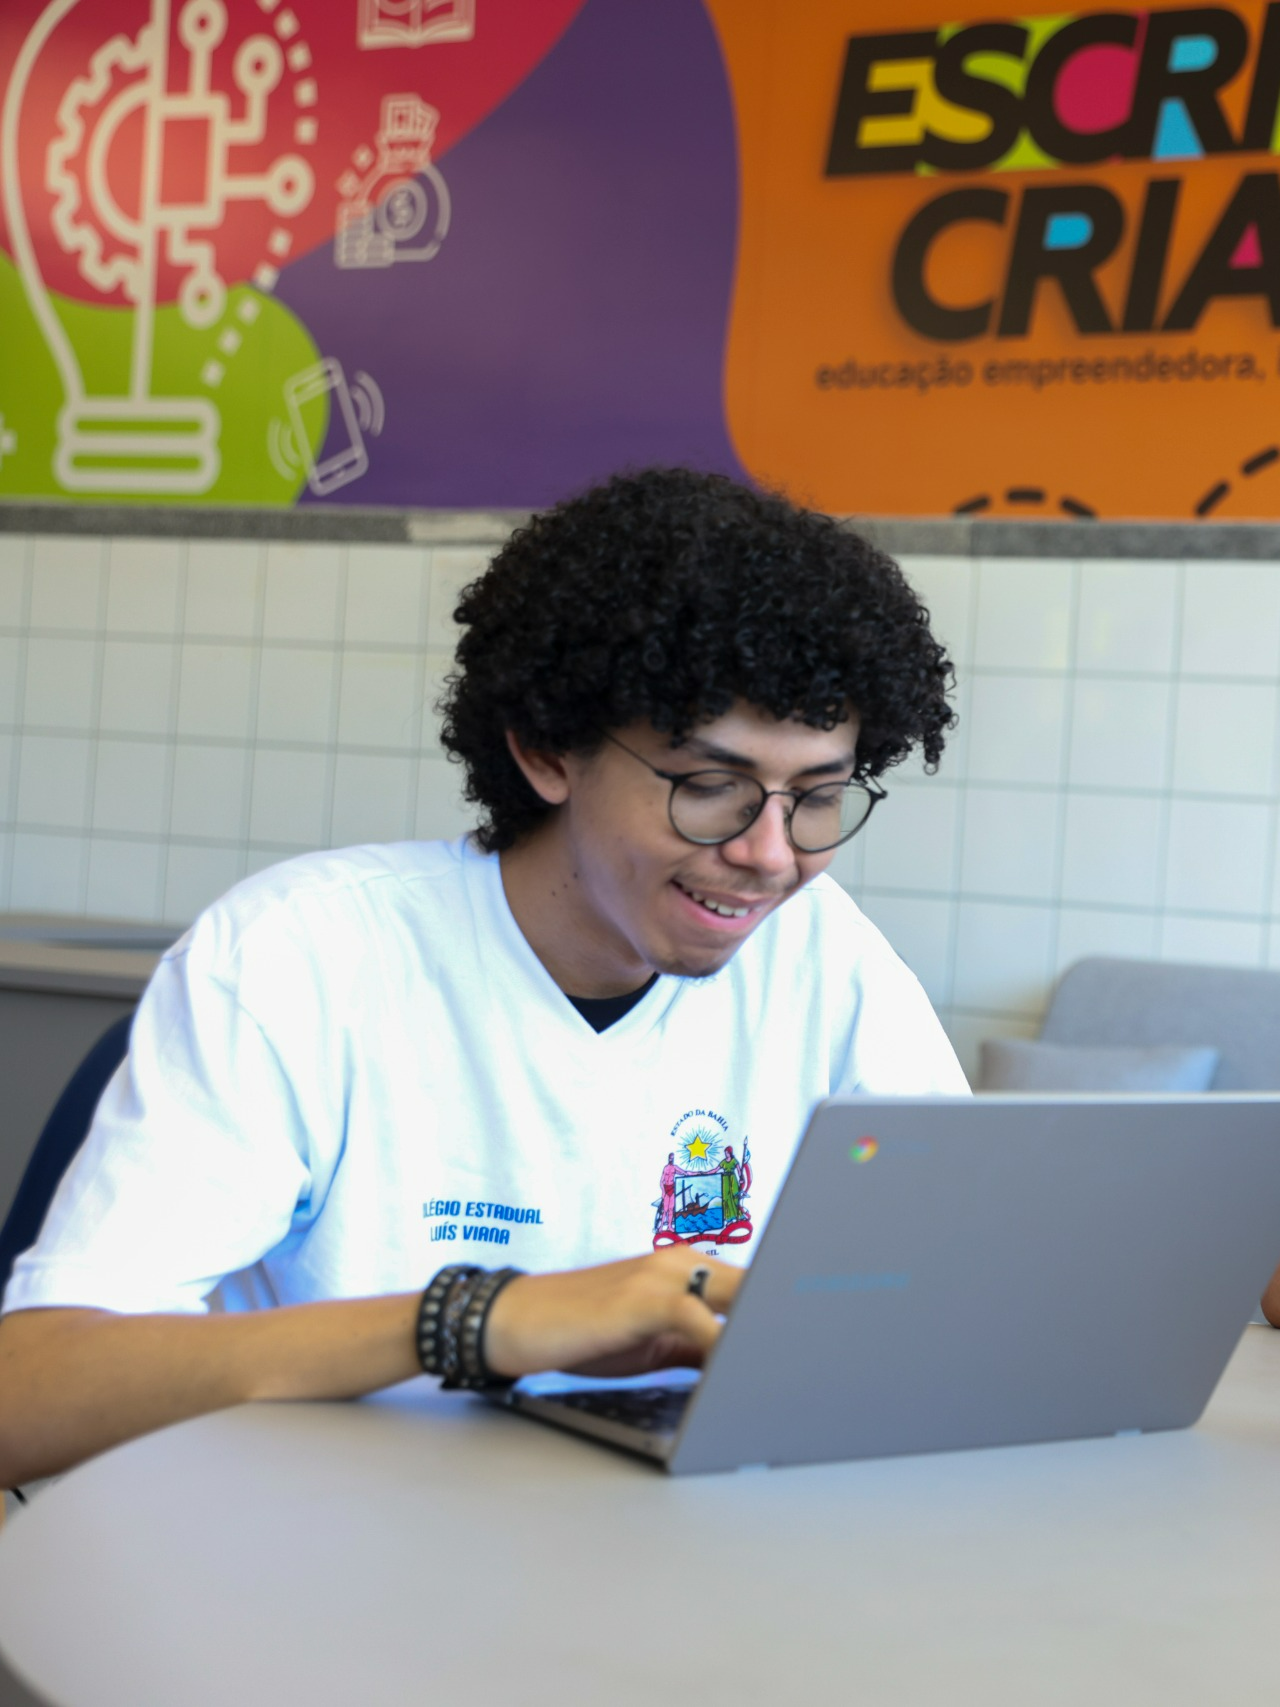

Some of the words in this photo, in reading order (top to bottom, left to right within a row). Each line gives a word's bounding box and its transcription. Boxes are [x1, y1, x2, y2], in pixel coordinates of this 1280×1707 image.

[815, 354, 975, 395] educação
[983, 347, 1266, 391] empreendedora,
[670, 1110, 694, 1136] ESTADO
[707, 1110, 729, 1132] BAHIA
[422, 1197, 462, 1218] LÉGIO
[465, 1201, 544, 1225] ESTADUAL
[430, 1221, 458, 1242] LUÍS
[463, 1225, 510, 1245] VIANA
